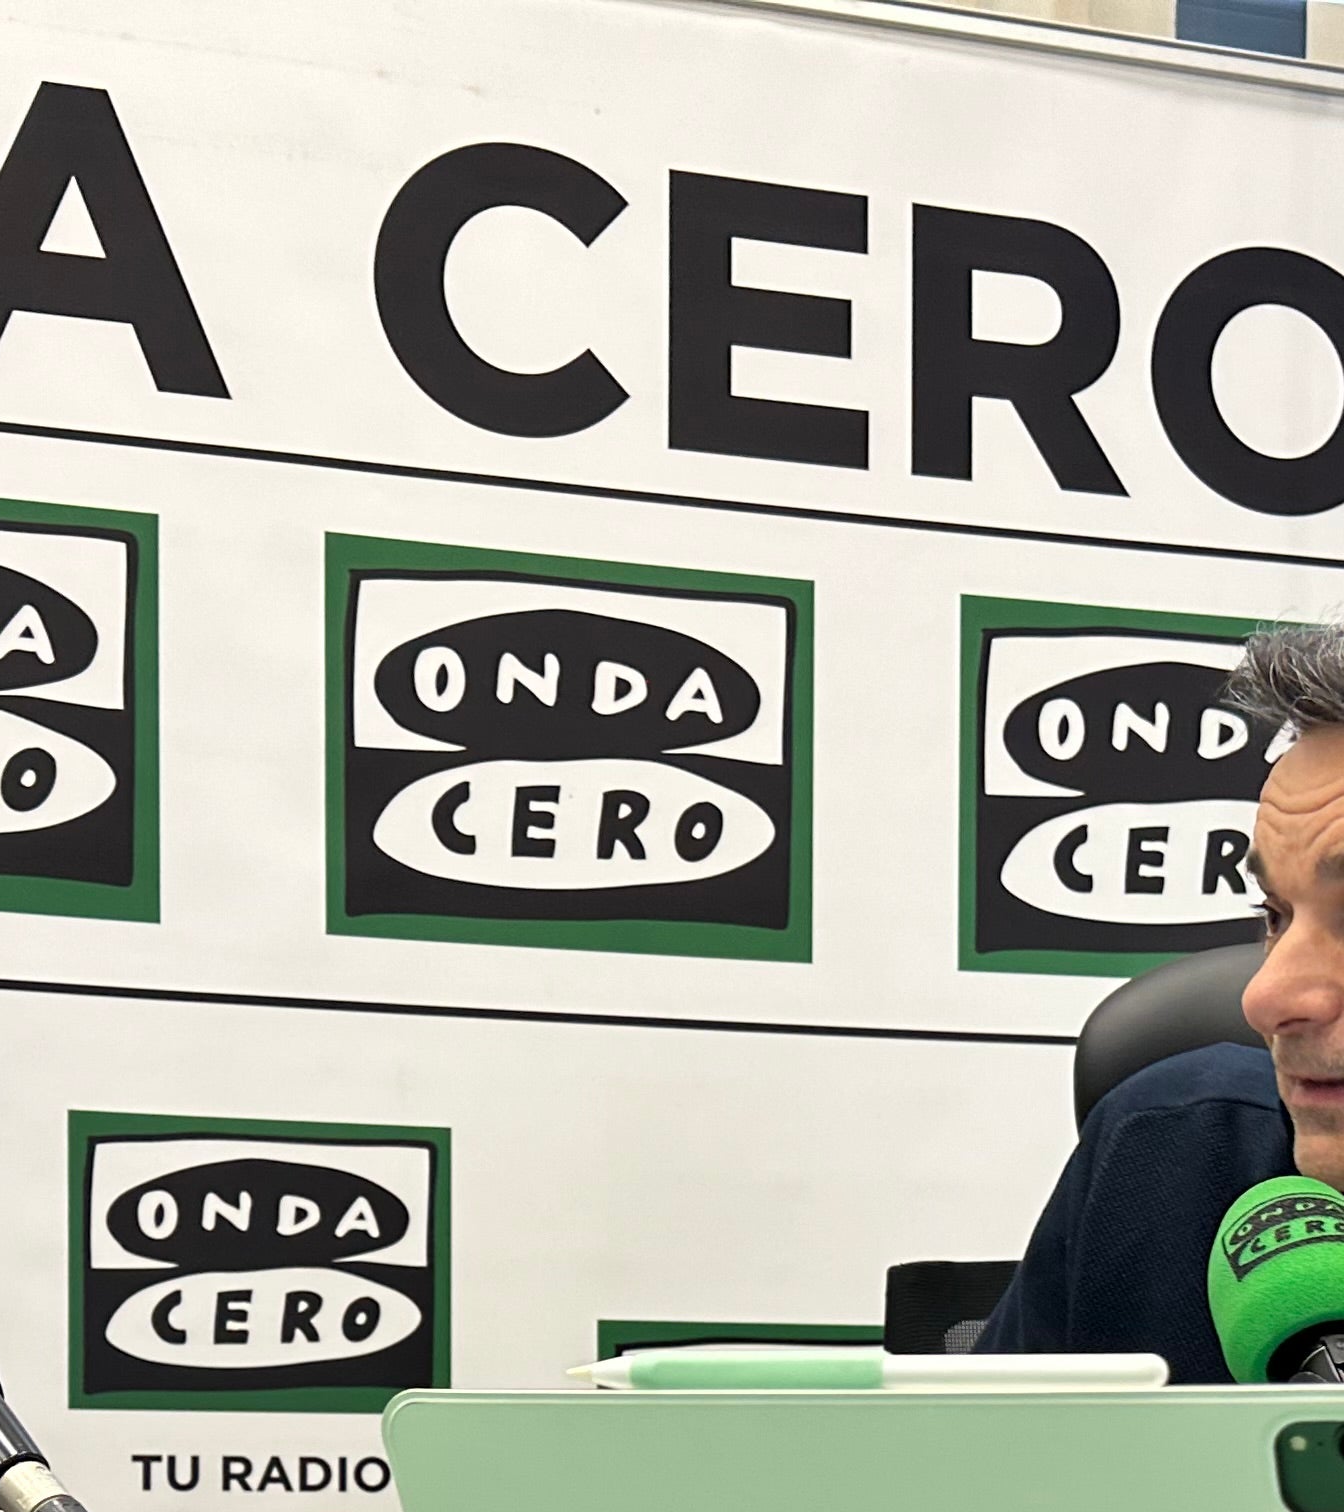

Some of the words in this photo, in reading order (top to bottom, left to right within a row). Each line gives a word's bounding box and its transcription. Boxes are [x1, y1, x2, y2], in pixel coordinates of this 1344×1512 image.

[413, 647, 724, 724] ONDA
[432, 784, 724, 862] CERO
[1054, 824, 1250, 894] CER
[137, 1190, 380, 1240] ONDA
[1237, 1203, 1344, 1236] ONDA
[152, 1290, 381, 1345] CERO
[132, 1455, 200, 1491] TU
[223, 1455, 391, 1493] RADIO
